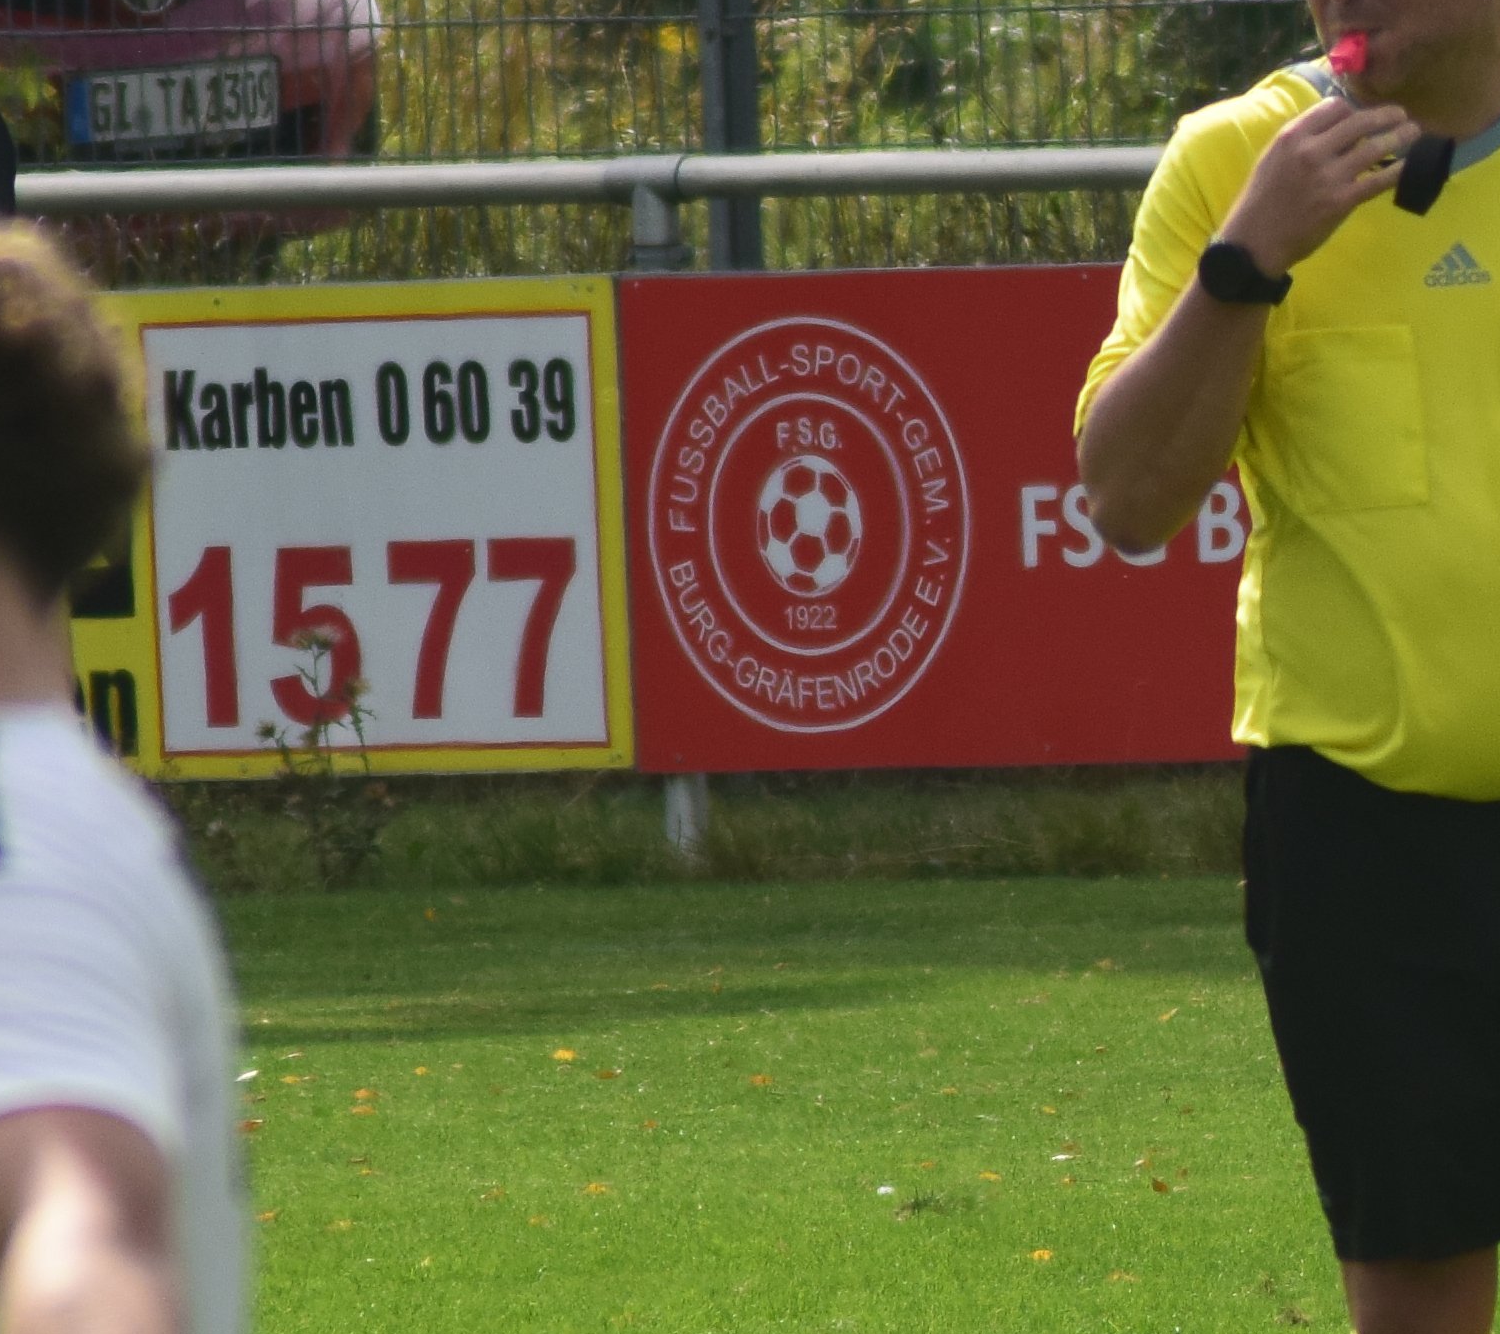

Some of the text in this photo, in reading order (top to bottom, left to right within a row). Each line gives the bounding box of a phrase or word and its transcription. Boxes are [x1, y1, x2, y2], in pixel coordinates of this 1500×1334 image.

[163, 358, 577, 452] Karben 0 60 39
[1021, 482, 1167, 569] FS
[669, 560, 929, 710] BURG-GRÄFENRODE
[783, 605, 838, 630] 1922
